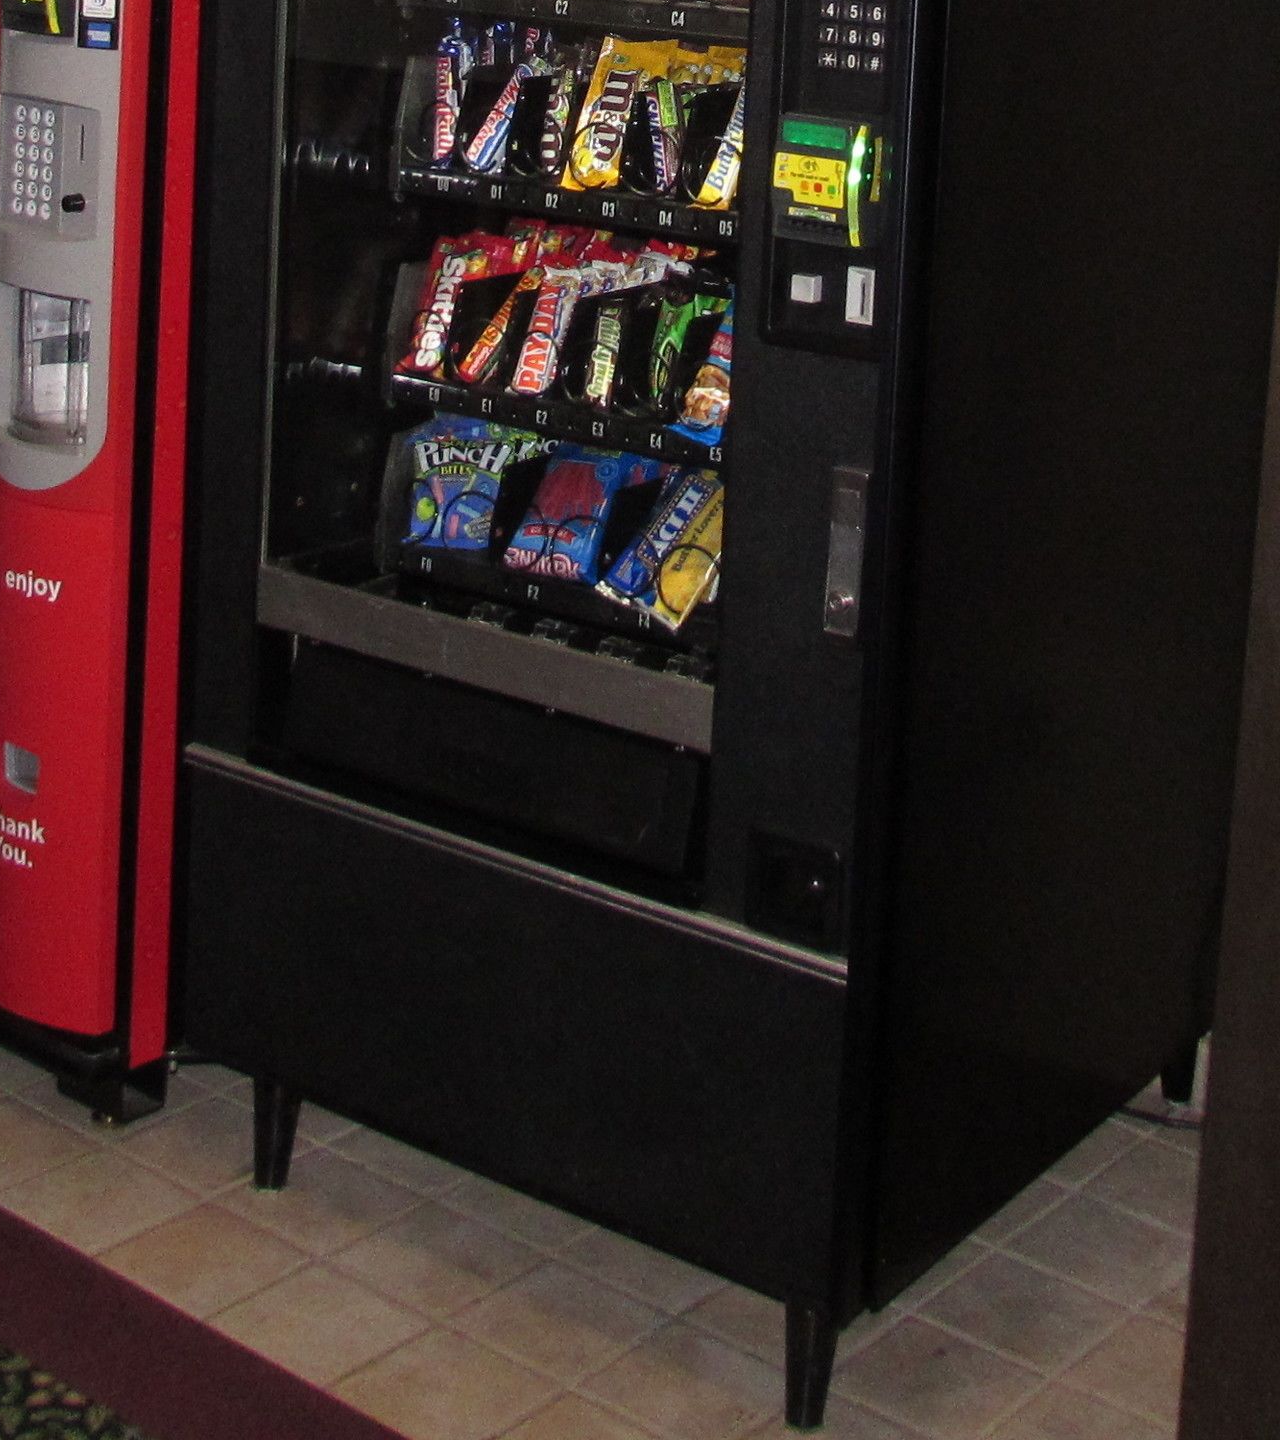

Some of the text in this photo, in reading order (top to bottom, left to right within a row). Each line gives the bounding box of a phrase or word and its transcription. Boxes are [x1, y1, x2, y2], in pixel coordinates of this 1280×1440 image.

[555, 0, 569, 15] C2
[826, 3, 881, 21] 4 5 6
[671, 11, 685, 27] C4
[826, 28, 880, 46] 7 8 9
[847, 54, 856, 69] 0
[481, 399, 492, 414] E1
[536, 410, 548, 425] E2
[592, 421, 604, 436] E3
[650, 433, 662, 449] E4
[709, 446, 722, 462] E5
[649, 510, 691, 559] ACT
[5, 569, 62, 603] enjoy
